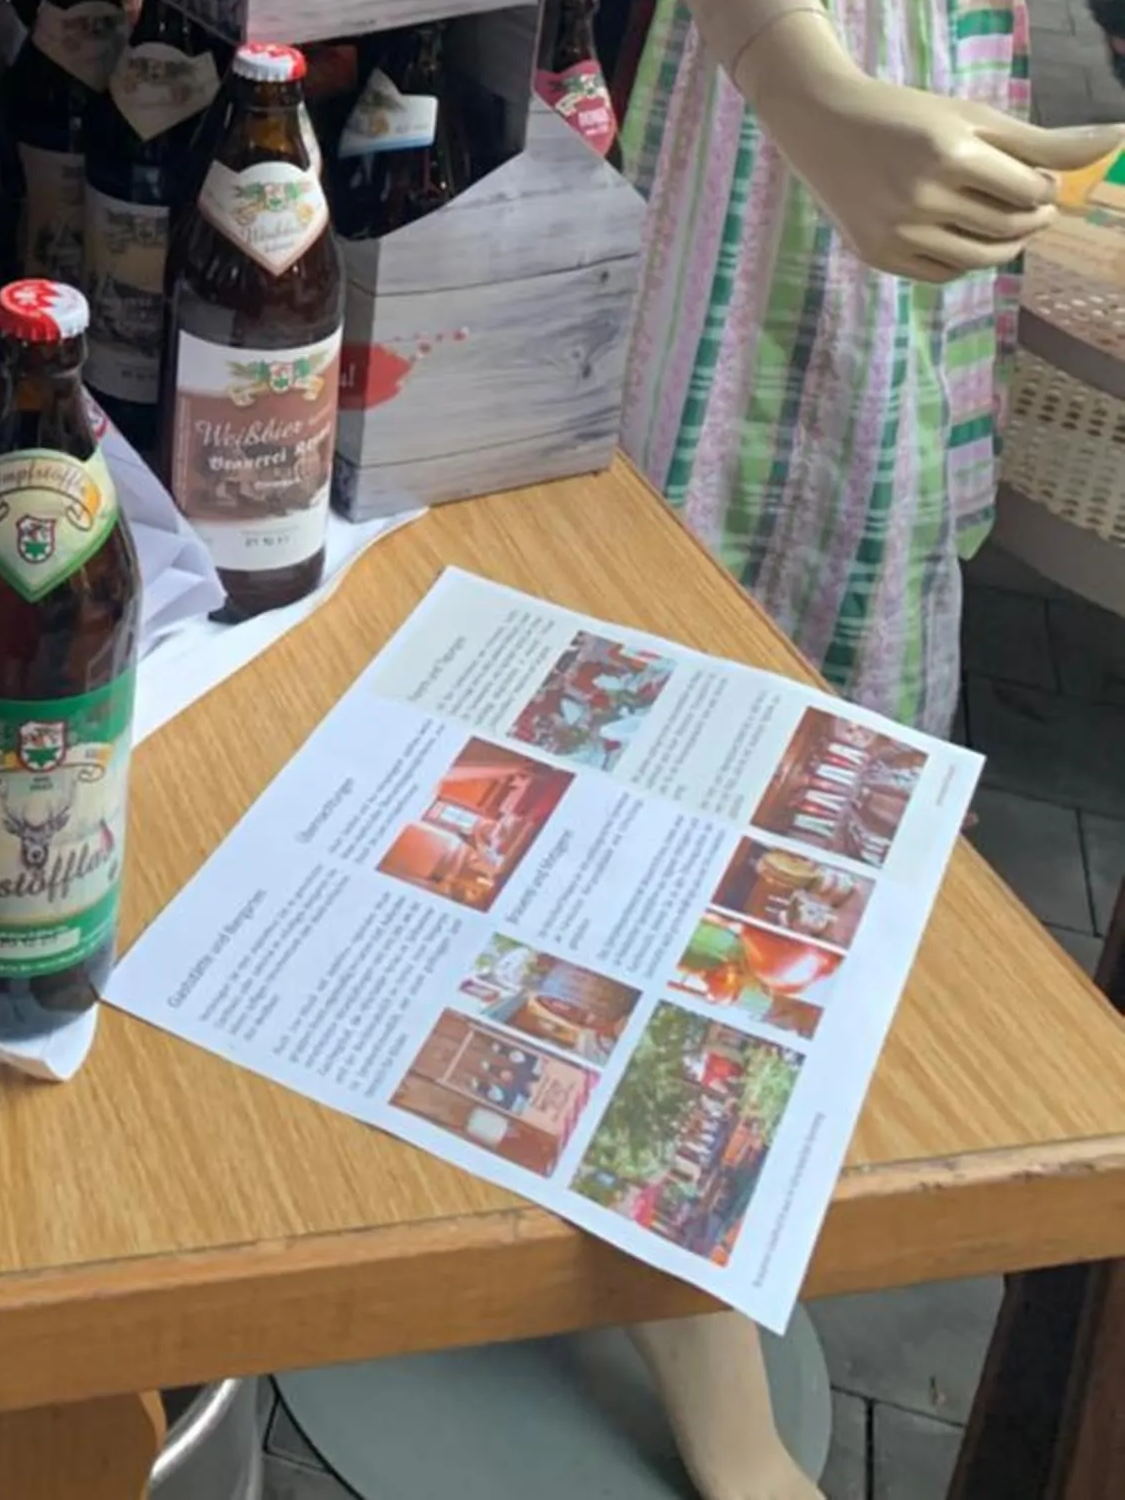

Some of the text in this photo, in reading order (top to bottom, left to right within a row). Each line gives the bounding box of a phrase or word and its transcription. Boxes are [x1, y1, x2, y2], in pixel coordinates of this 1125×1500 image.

[164, 886, 271, 1010] Gaststätte und Biergarten
